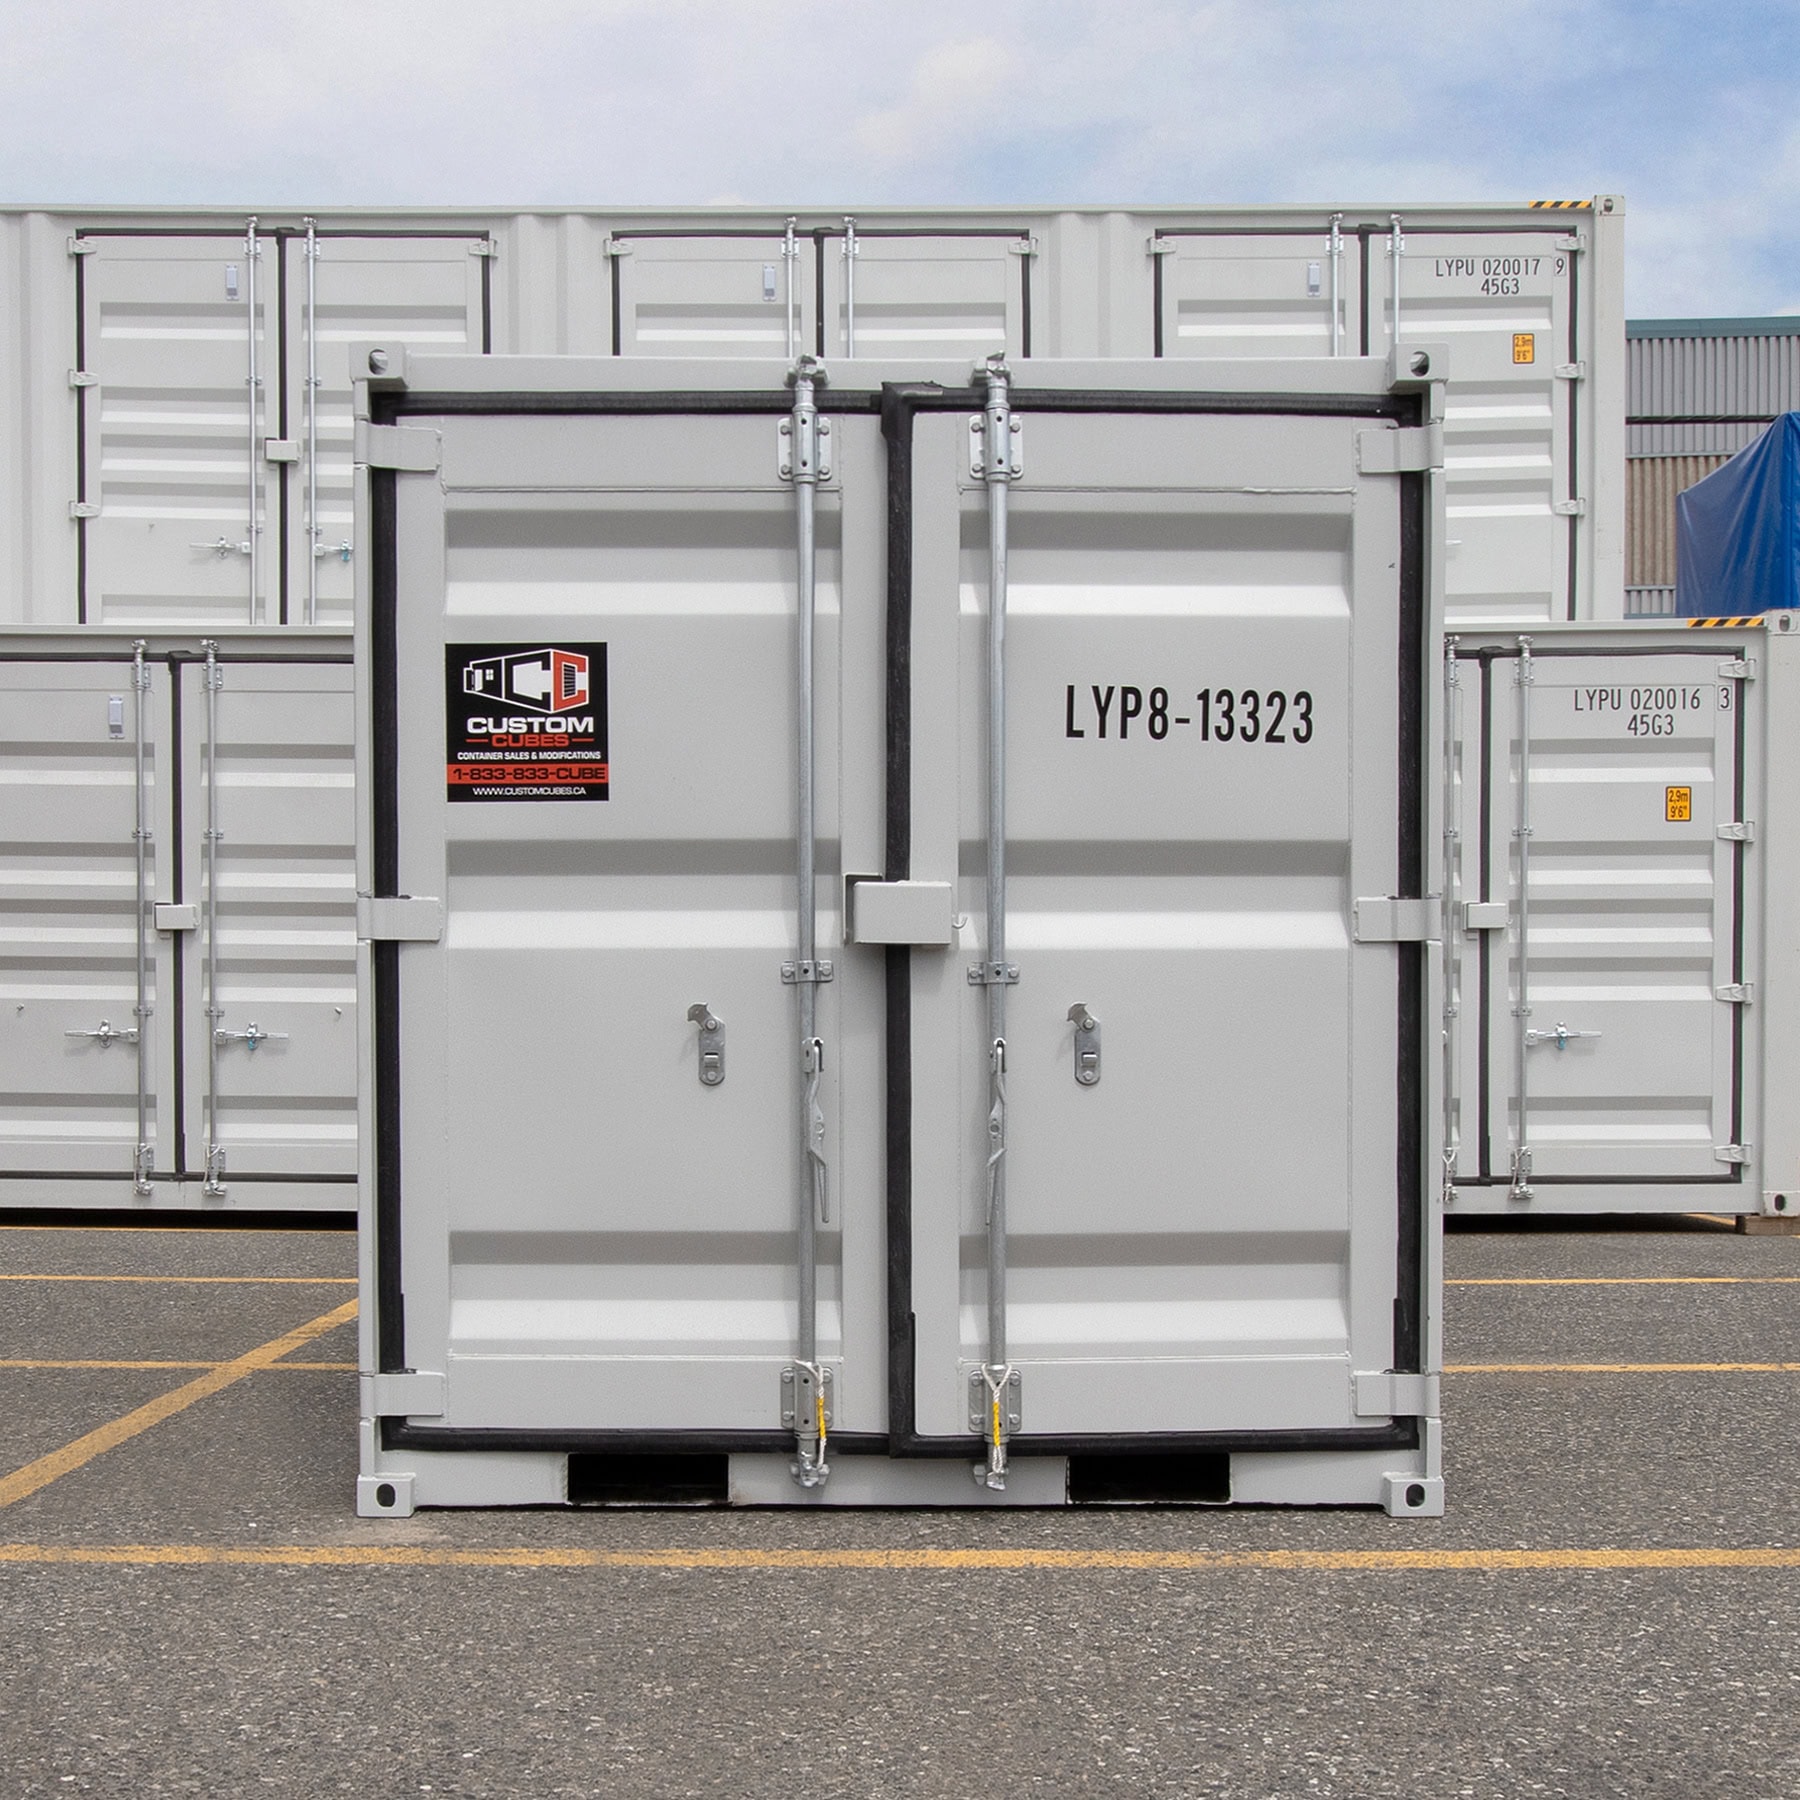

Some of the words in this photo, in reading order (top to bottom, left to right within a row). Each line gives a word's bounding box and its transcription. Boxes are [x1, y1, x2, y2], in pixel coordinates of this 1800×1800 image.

[1435, 258, 1475, 277] LYPU
[1482, 258, 1541, 276] 020017
[1555, 257, 1565, 275] 9
[1480, 278, 1520, 295] 45G3
[1574, 688, 1622, 711] LYPU
[1630, 688, 1701, 710] 020016
[1719, 687, 1730, 709] 3
[1066, 684, 1313, 743] LYP8-13323
[466, 716, 594, 734] CUSTOM
[1627, 713, 1675, 736] 45G3
[491, 733, 570, 748] CUBES
[457, 752, 503, 761] CONTAINER
[504, 752, 530, 761] SALES
[531, 752, 538, 761] &
[538, 751, 601, 760] MODIFICATIONS
[453, 767, 606, 781] 1-833-833-CUBE
[472, 786, 587, 796] WWW.CUSTOMCUBES.CA
